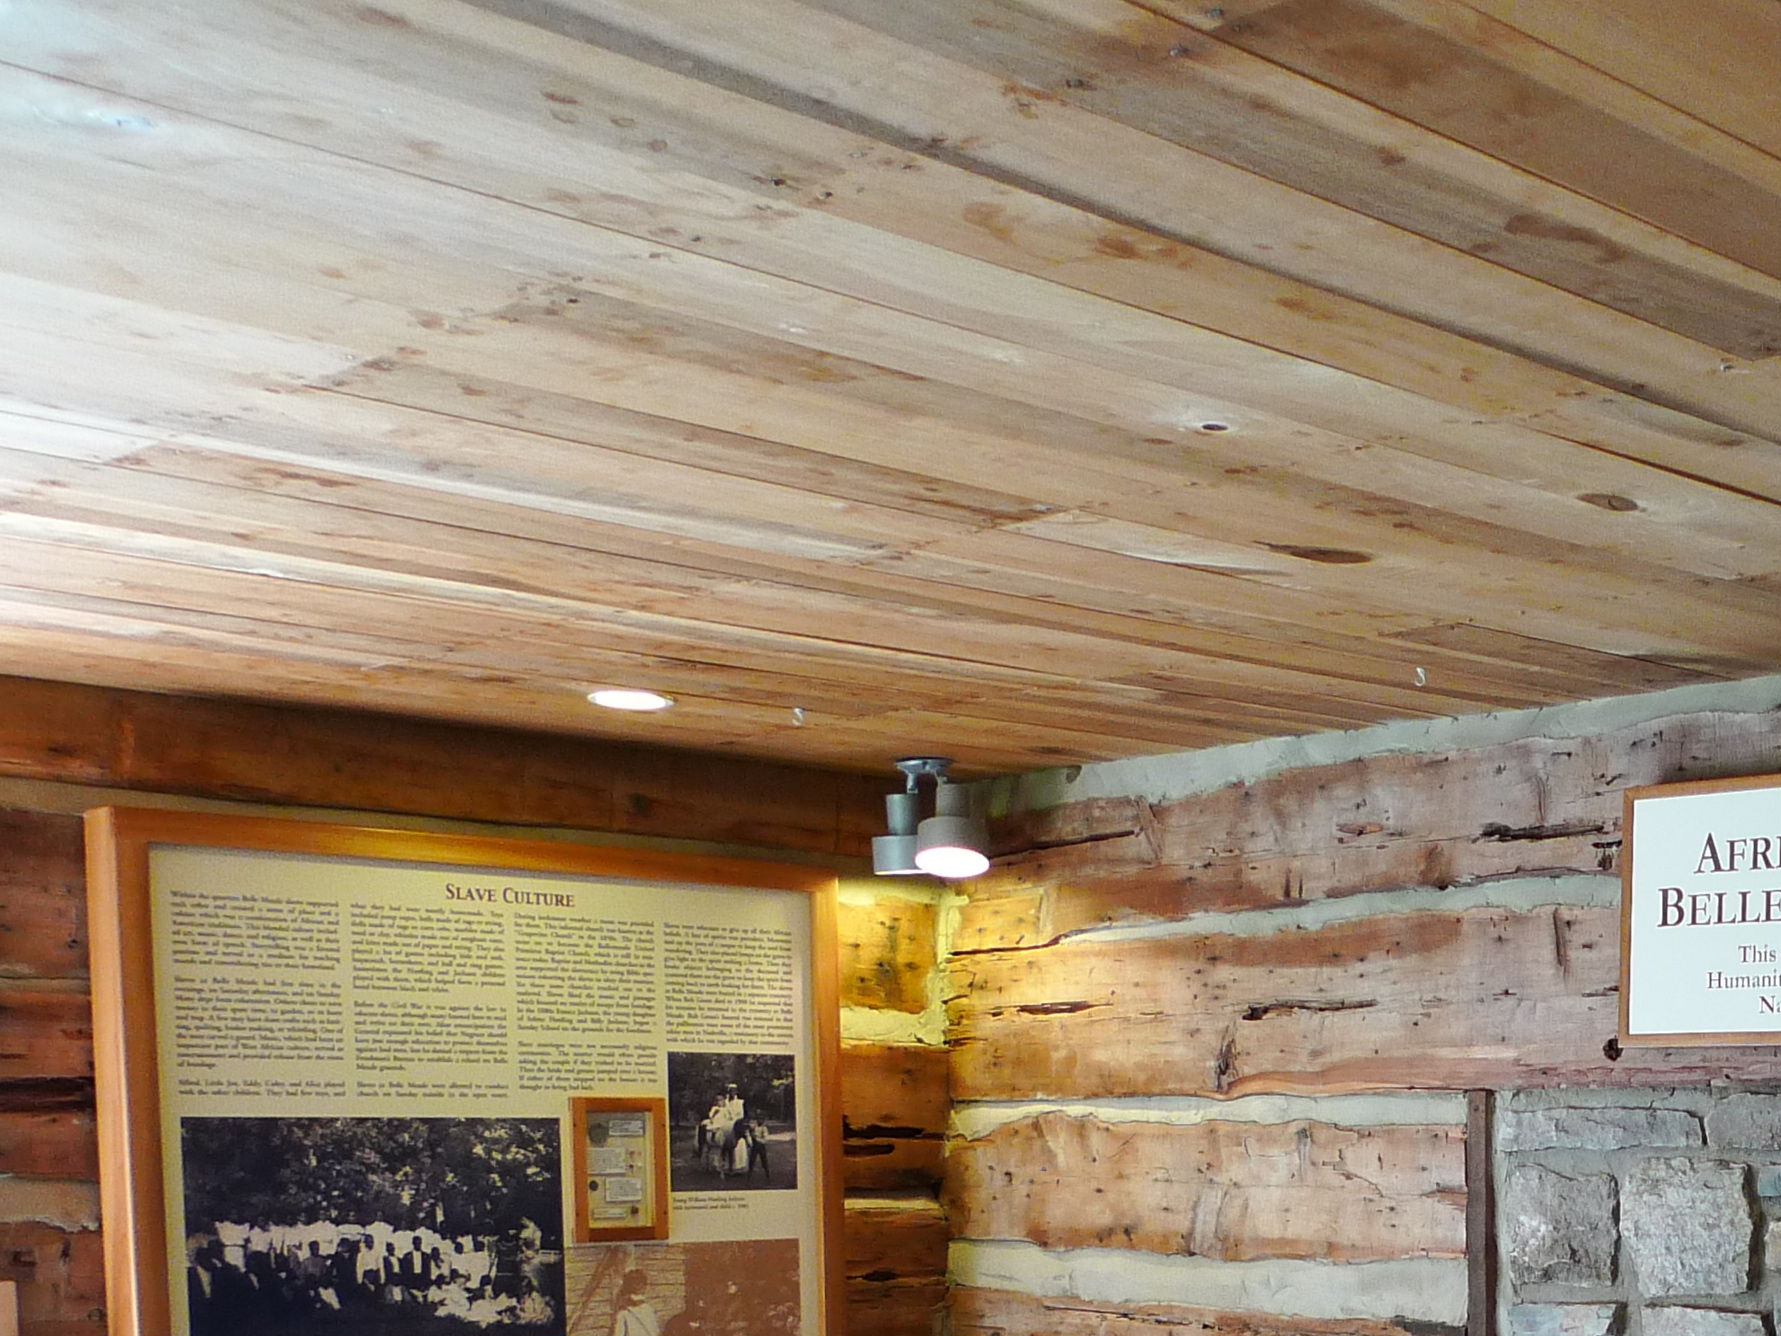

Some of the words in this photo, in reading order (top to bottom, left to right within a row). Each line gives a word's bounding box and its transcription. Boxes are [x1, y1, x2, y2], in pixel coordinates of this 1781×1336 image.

[446, 884, 496, 902] SLAVE
[503, 888, 574, 907] CULTURE
[1739, 944, 1776, 963] This
